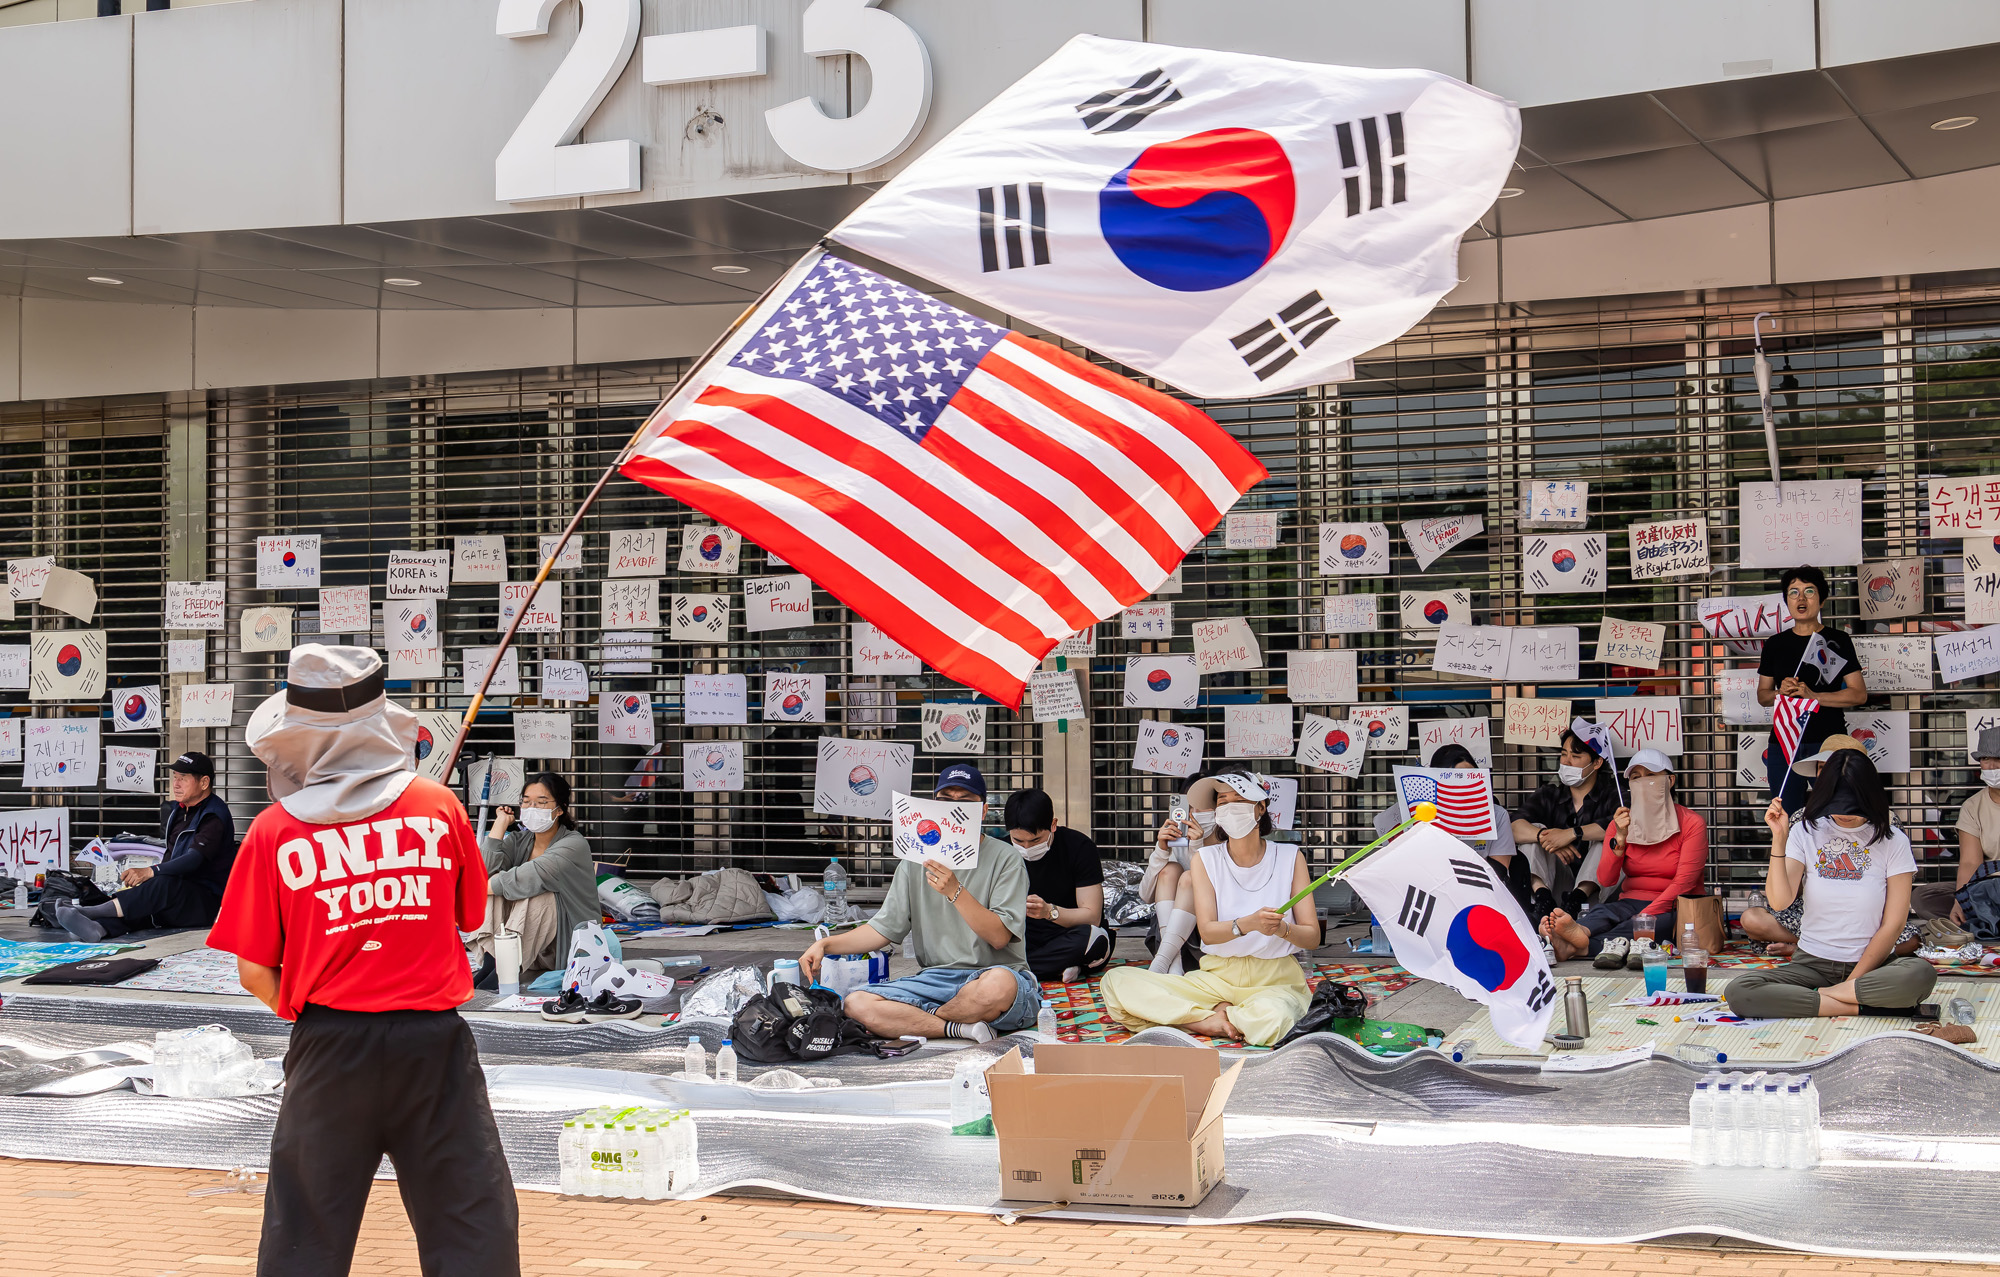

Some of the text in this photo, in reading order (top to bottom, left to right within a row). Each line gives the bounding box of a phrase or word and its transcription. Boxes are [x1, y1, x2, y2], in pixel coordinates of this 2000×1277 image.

[496, 0, 933, 203] 2-3
[1540, 508, 1577, 522] 수개표
[260, 538, 318, 553] 부정선거 재선거
[616, 532, 656, 553] 재선거
[1764, 527, 1807, 551] 한동훈
[391, 554, 447, 566] Democracy in
[461, 549, 489, 561] GATE
[390, 568, 426, 579] KOREA
[169, 586, 222, 598] We Are Fighting
[390, 584, 416, 595] Under
[610, 583, 651, 600] 부정선거
[746, 581, 791, 595] Election
[171, 598, 224, 610] For FREEDOM
[770, 597, 810, 613] Fraud
[171, 612, 181, 620] For
[521, 612, 558, 626] STEAL
[1443, 634, 1502, 657] 재선거
[1521, 641, 1567, 661] 재선거
[1943, 636, 1993, 657] 재선거
[859, 646, 880, 665] Stop
[772, 677, 811, 693] 재선거
[185, 688, 232, 704] 재선거
[1533, 704, 1568, 723] 재선거
[1424, 722, 1484, 746] 재선거
[34, 739, 85, 757] 재선거
[843, 745, 887, 772] 재선거
[0, 817, 61, 867] 재선거
[1818, 867, 1863, 879] adidas
[314, 875, 431, 921] YOON
[325, 924, 349, 935] MAKE
[350, 918, 373, 929] YOON
[591, 1151, 622, 1164] OMG
